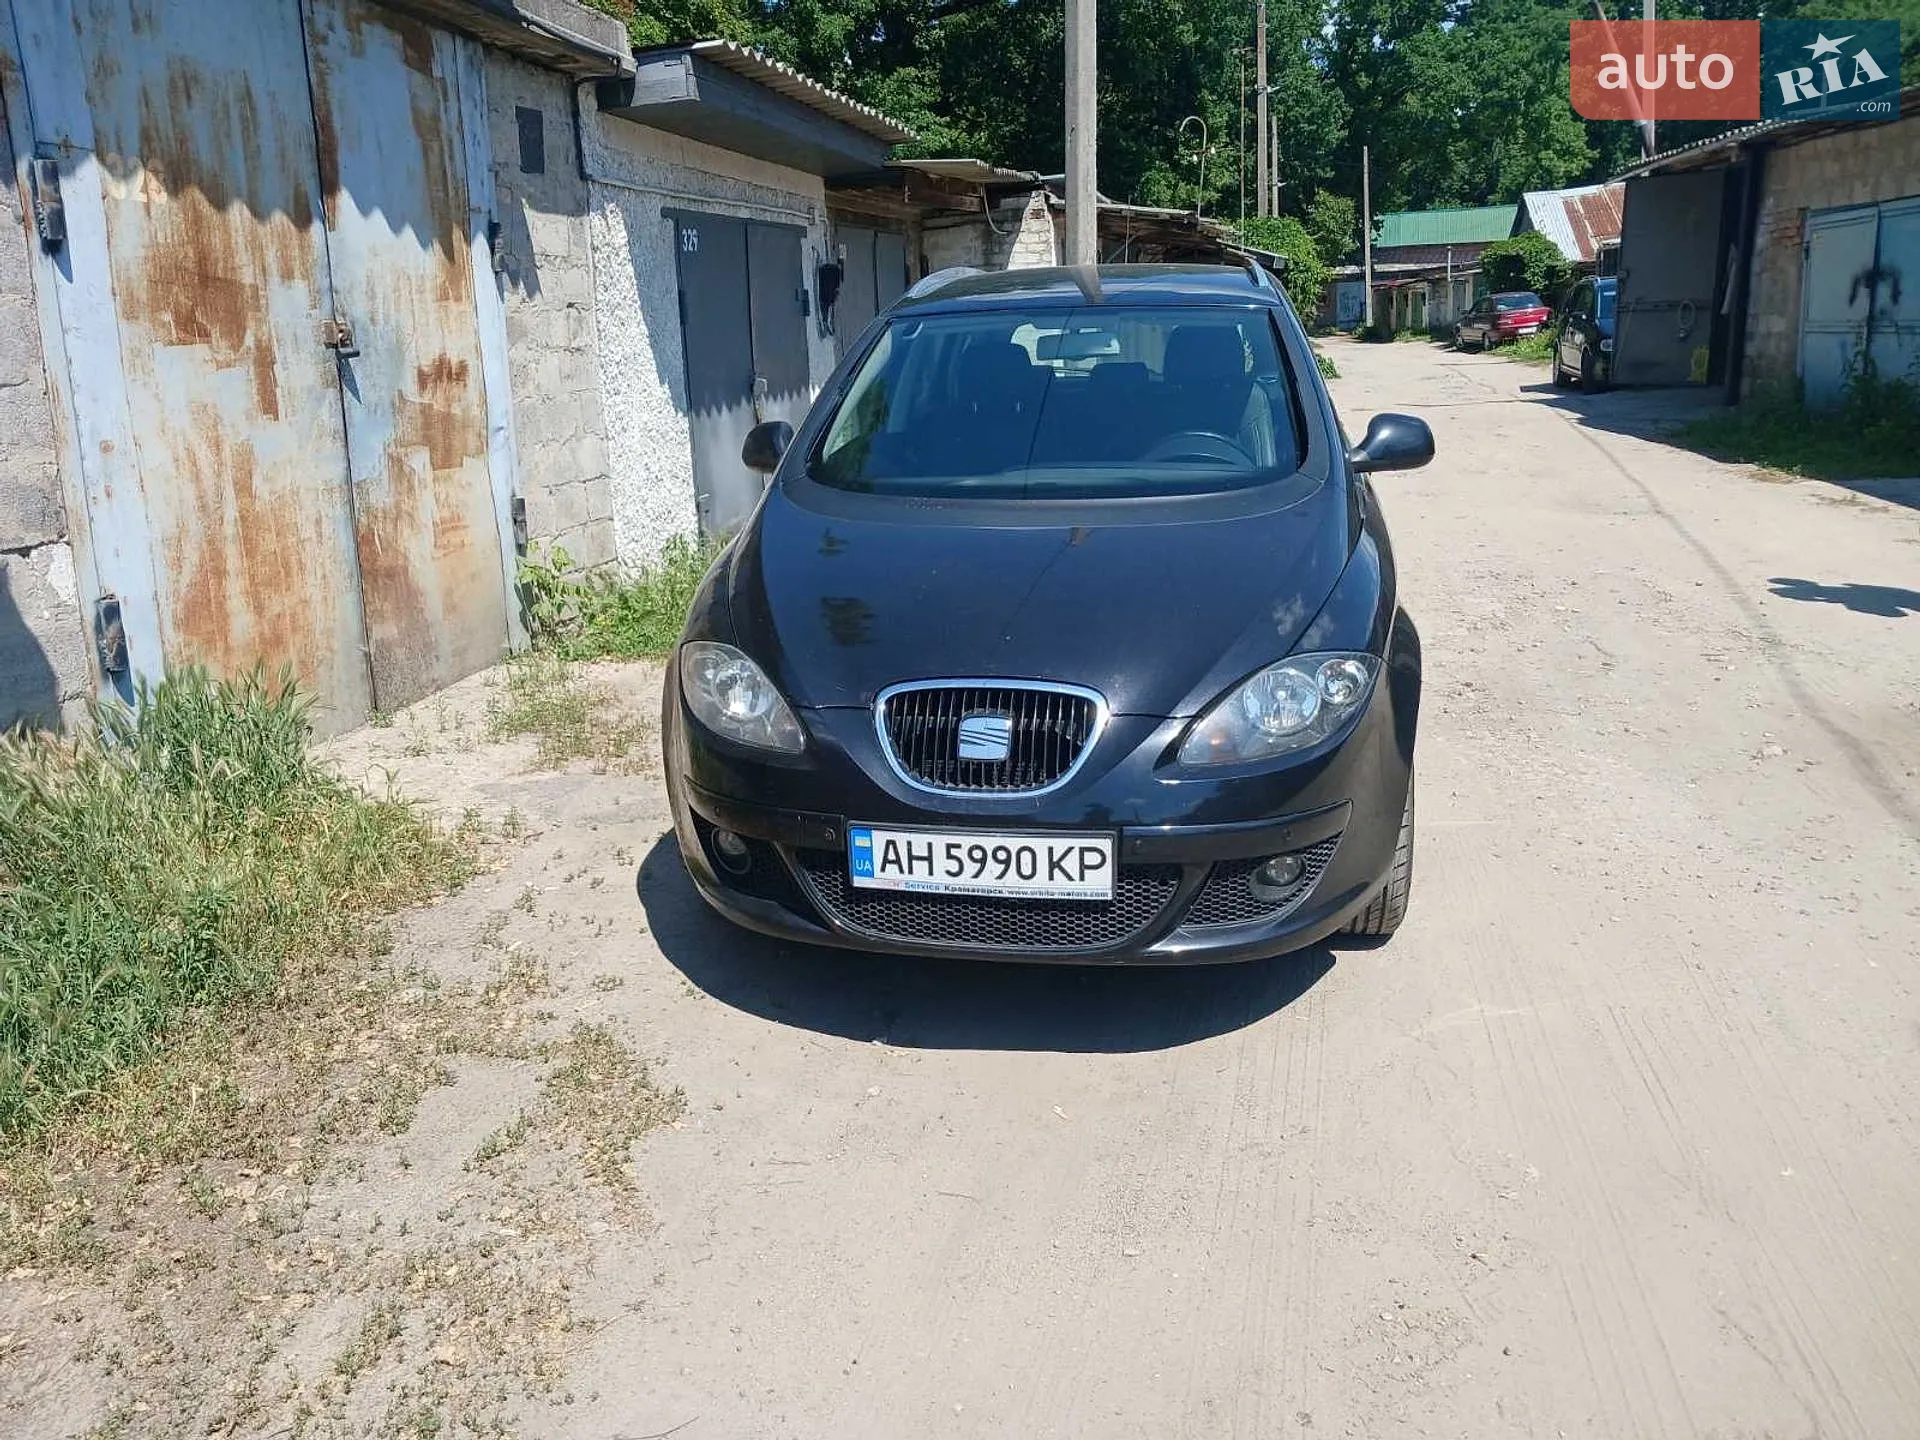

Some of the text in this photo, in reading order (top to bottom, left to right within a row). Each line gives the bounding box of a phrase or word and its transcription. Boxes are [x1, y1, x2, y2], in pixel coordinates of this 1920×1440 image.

[855, 859, 872, 872] UA
[880, 838, 1107, 882] AH 5990 KP
